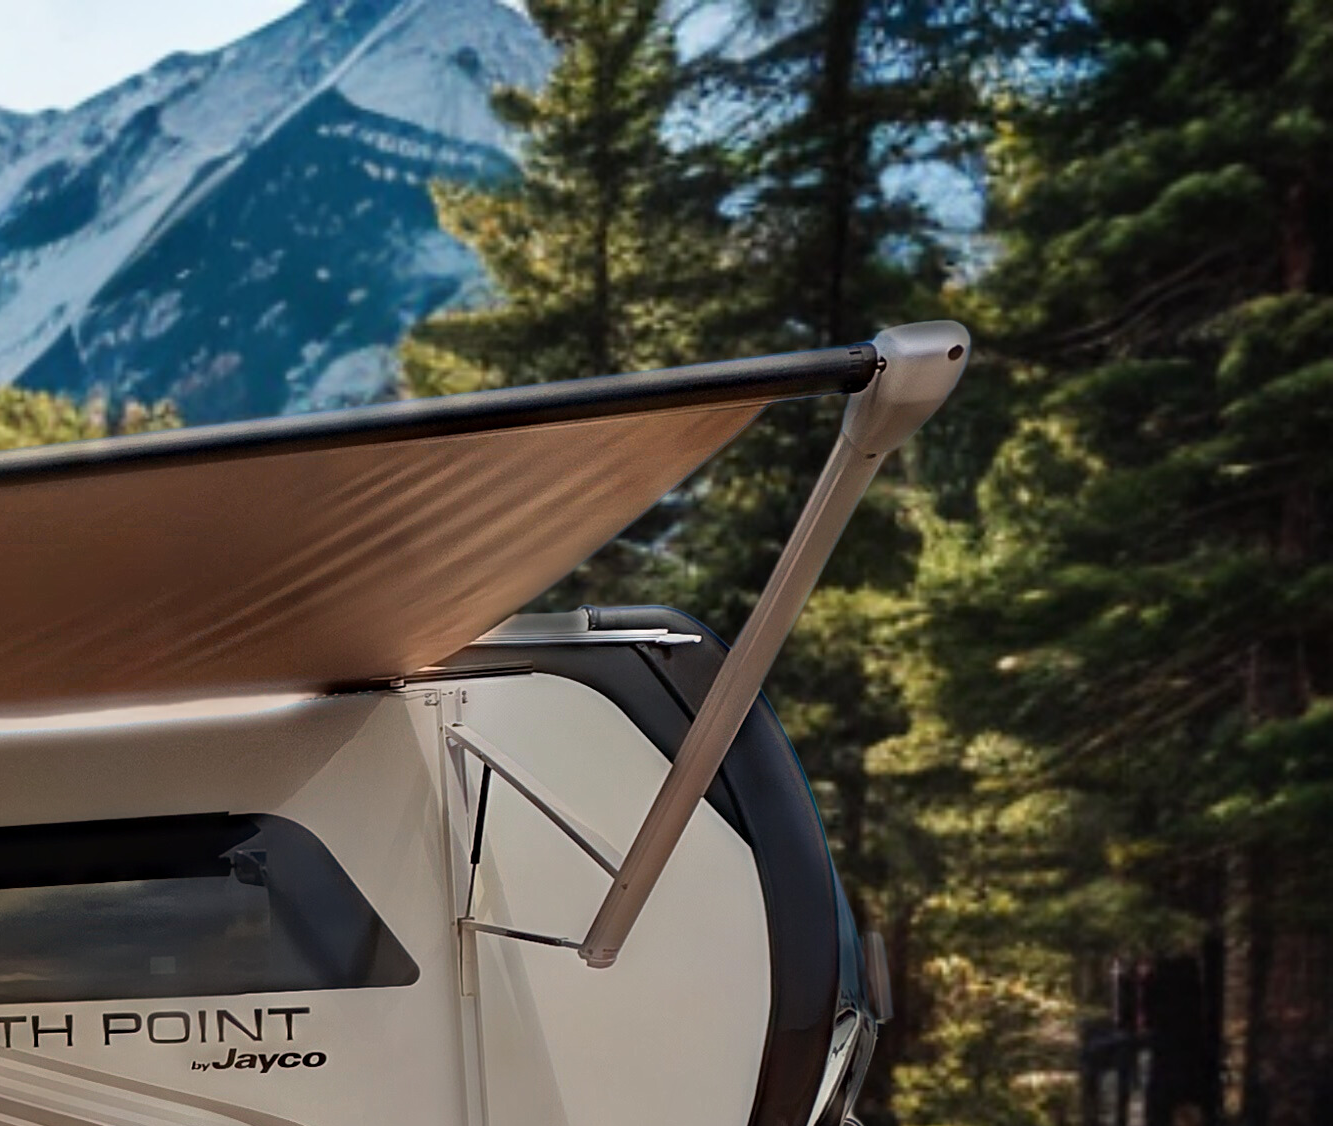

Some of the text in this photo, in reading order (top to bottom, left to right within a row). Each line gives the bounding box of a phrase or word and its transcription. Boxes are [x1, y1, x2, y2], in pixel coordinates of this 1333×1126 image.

[102, 1007, 310, 1046] POINT
[191, 1048, 327, 1073] by Jayco
